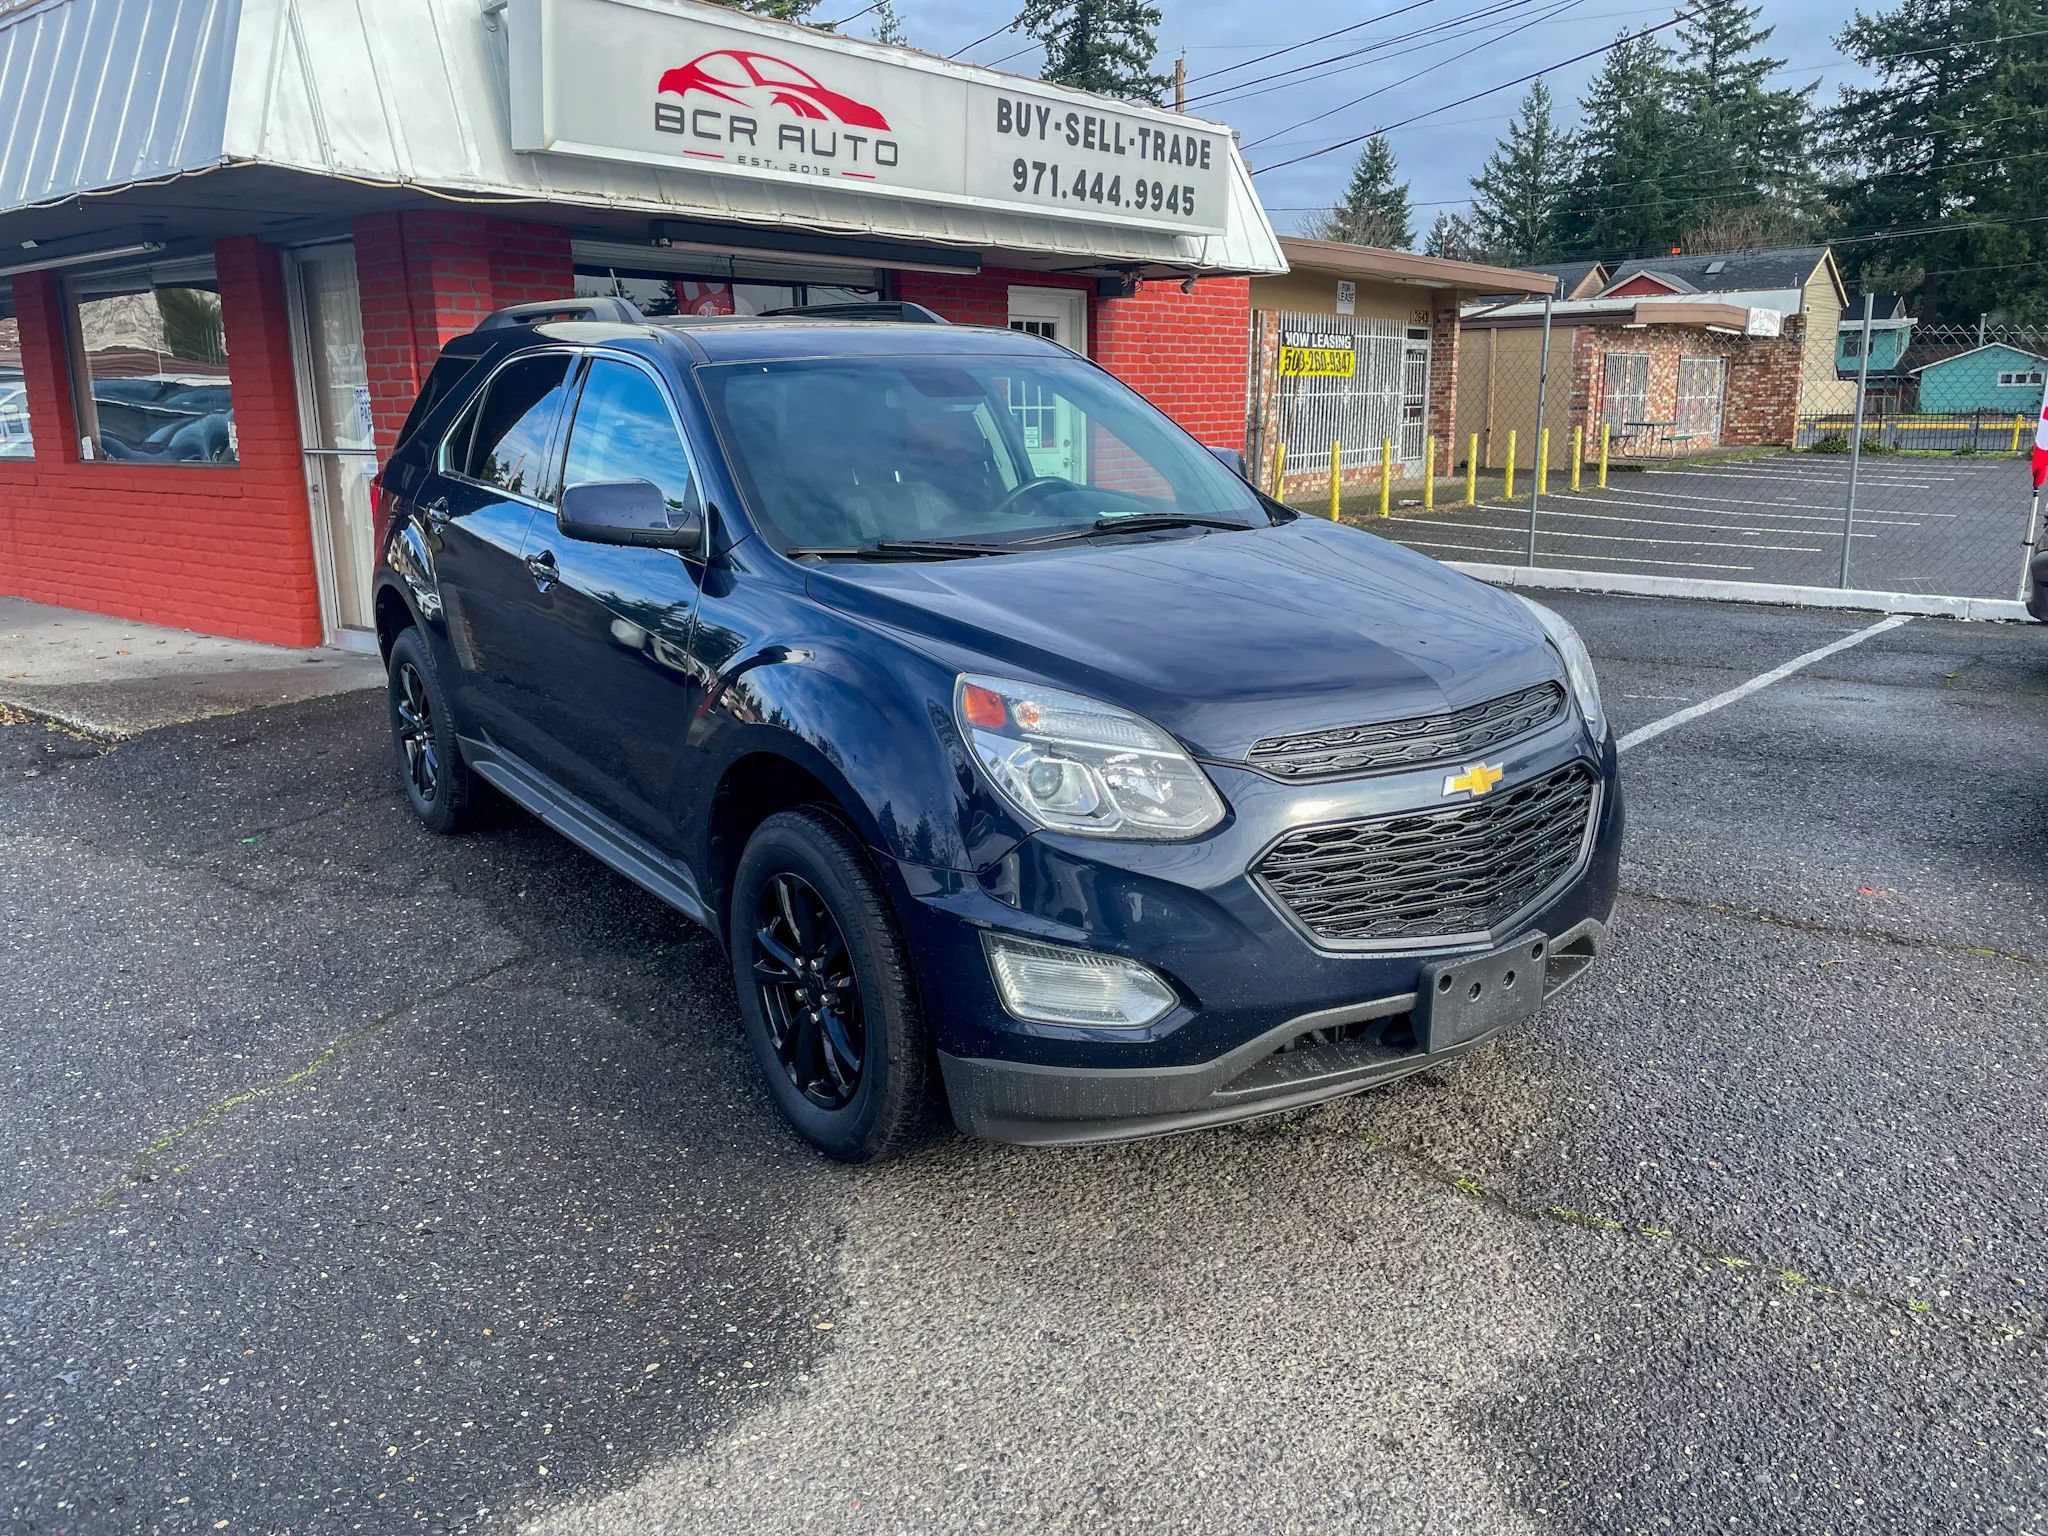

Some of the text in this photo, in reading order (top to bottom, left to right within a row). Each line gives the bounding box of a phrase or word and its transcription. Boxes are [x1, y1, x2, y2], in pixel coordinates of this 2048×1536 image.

[654, 101, 898, 167] BCR AUTO
[737, 155, 830, 176] EST. 2015
[1012, 158, 1195, 216] 971.444.9945
[1338, 292, 1355, 303] LEASE
[1285, 332, 1351, 349] NOW LEASING
[1283, 349, 1351, 373] 503-260-9347
